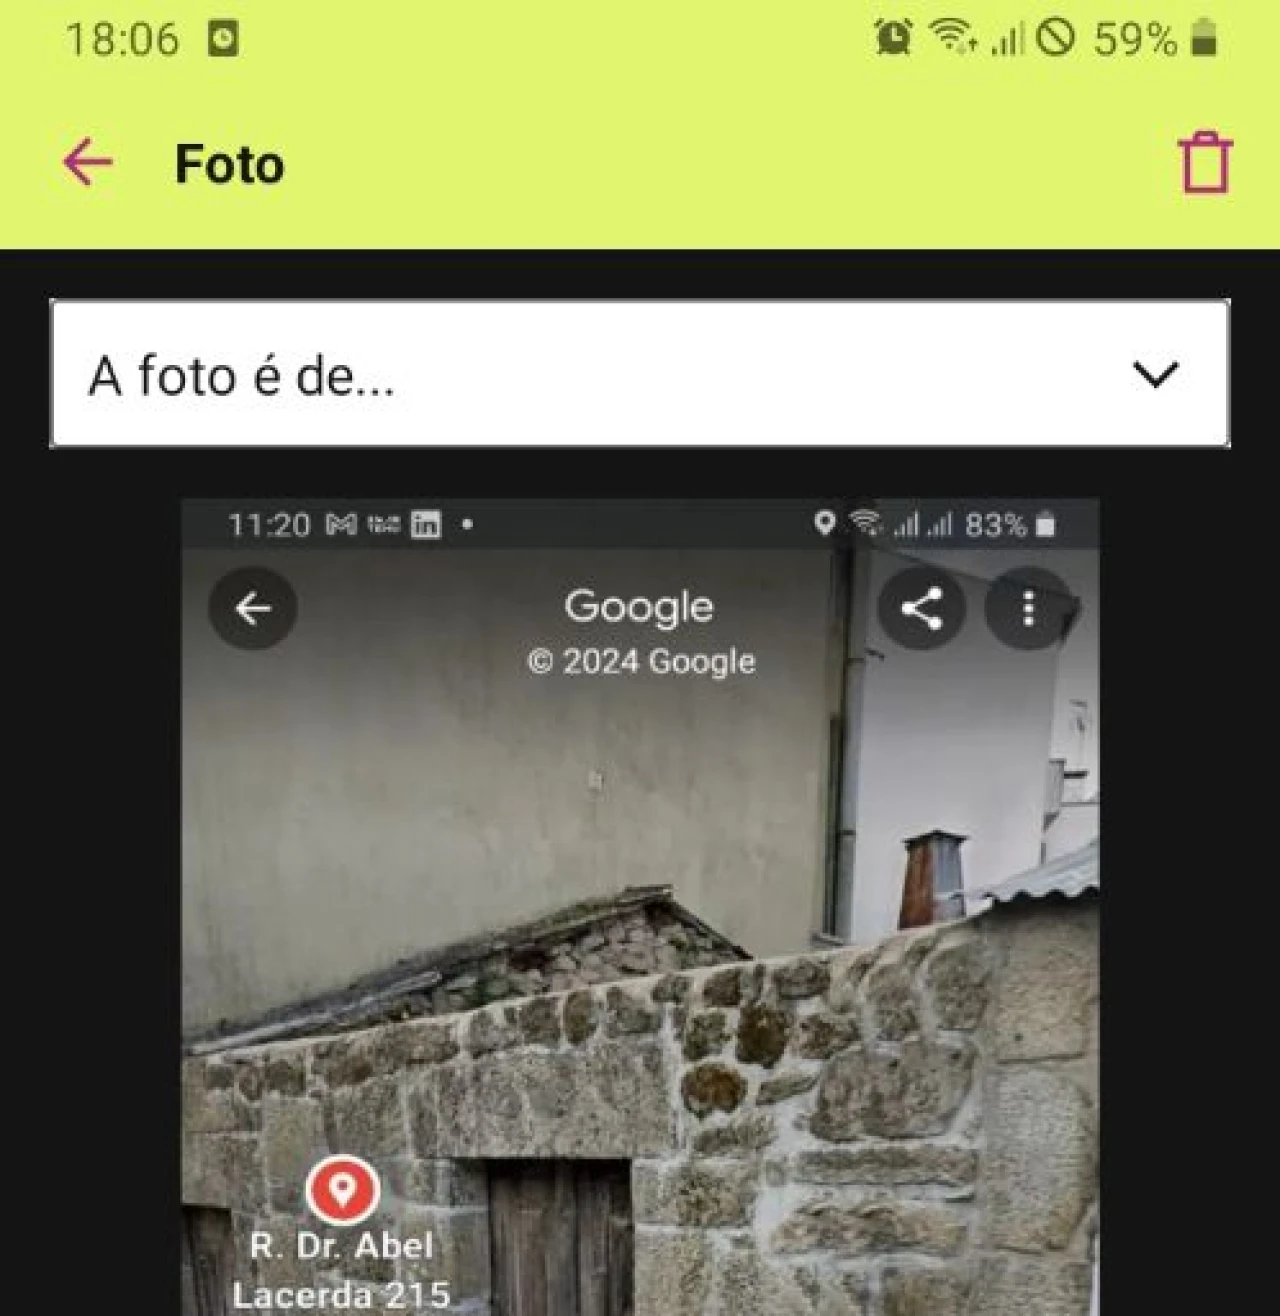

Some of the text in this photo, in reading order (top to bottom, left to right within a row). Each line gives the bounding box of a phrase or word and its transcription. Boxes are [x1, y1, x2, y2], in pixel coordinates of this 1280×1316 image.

[66, 21, 181, 58] 18:06
[1094, 21, 1178, 58] 59%
[176, 143, 286, 186] Foto
[88, 352, 395, 398] A foto é de...
[228, 512, 310, 537] 11:20
[965, 512, 1028, 538] 83%
[564, 588, 714, 630] Google
[564, 648, 638, 674] 2024
[649, 647, 756, 681] Google
[250, 1231, 433, 1258] R. Dr. Abel
[233, 1281, 451, 1309] Lacerda 215
